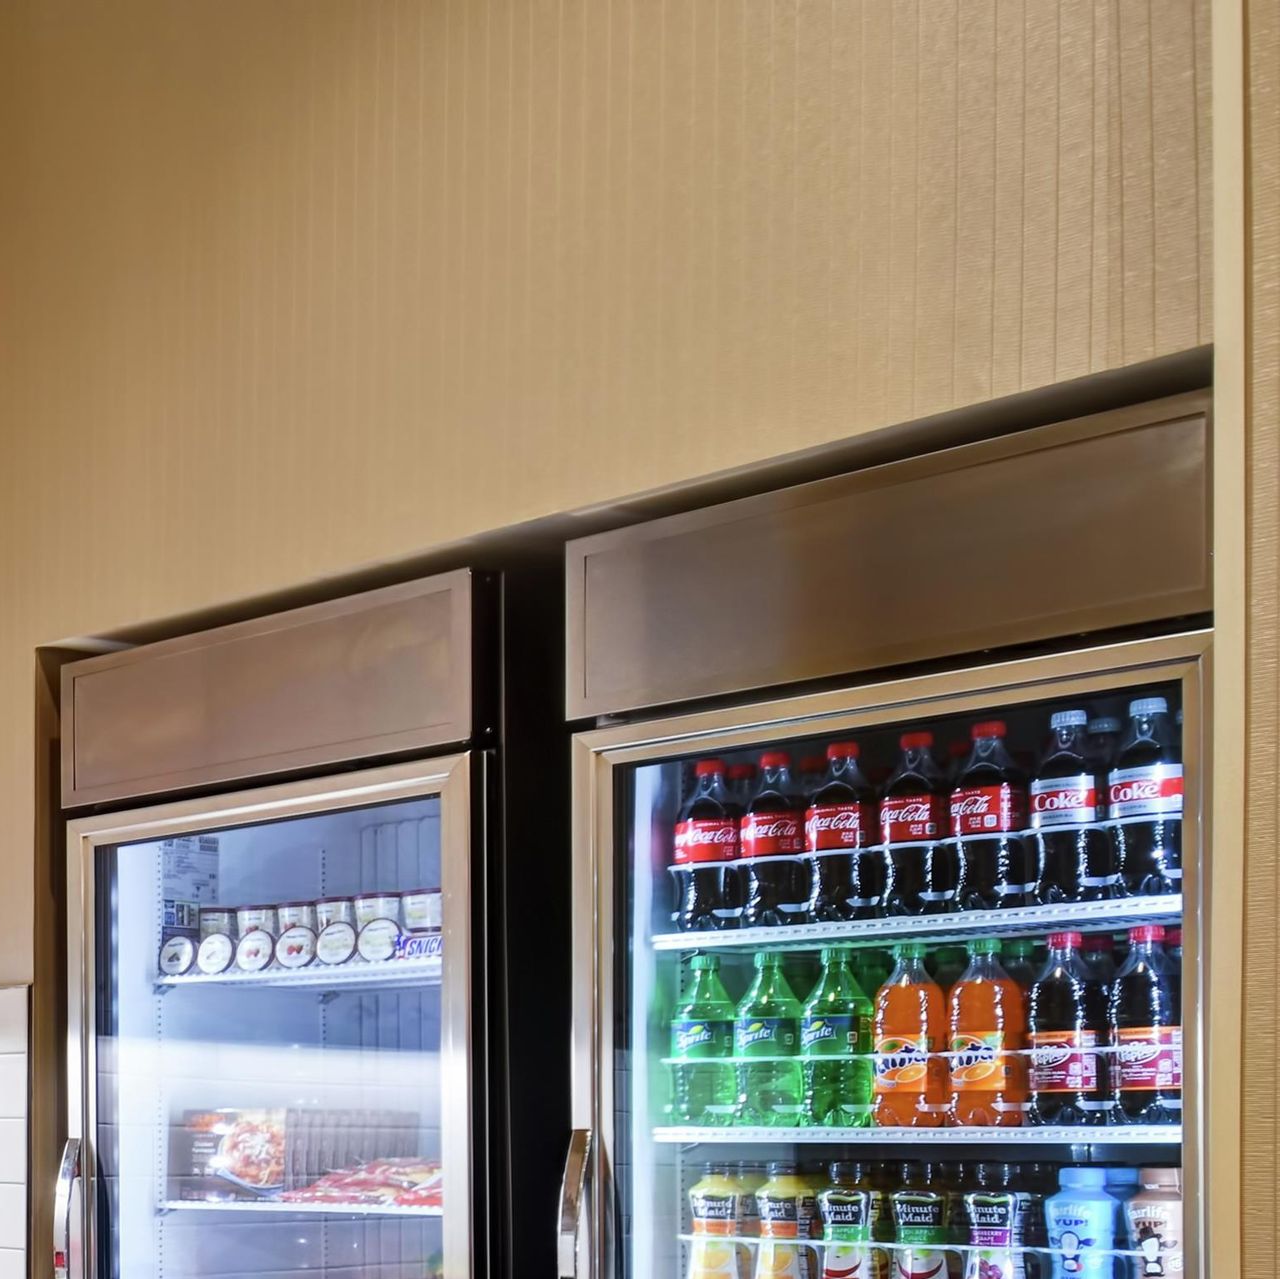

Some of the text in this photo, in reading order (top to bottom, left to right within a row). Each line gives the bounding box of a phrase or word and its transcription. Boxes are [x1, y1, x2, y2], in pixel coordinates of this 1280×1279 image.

[1033, 790, 1088, 811] Coke
[1110, 781, 1160, 802] Coke
[950, 795, 992, 816] ca-Cola
[896, 1205, 940, 1213] Minute
[902, 1213, 934, 1223] Maid
